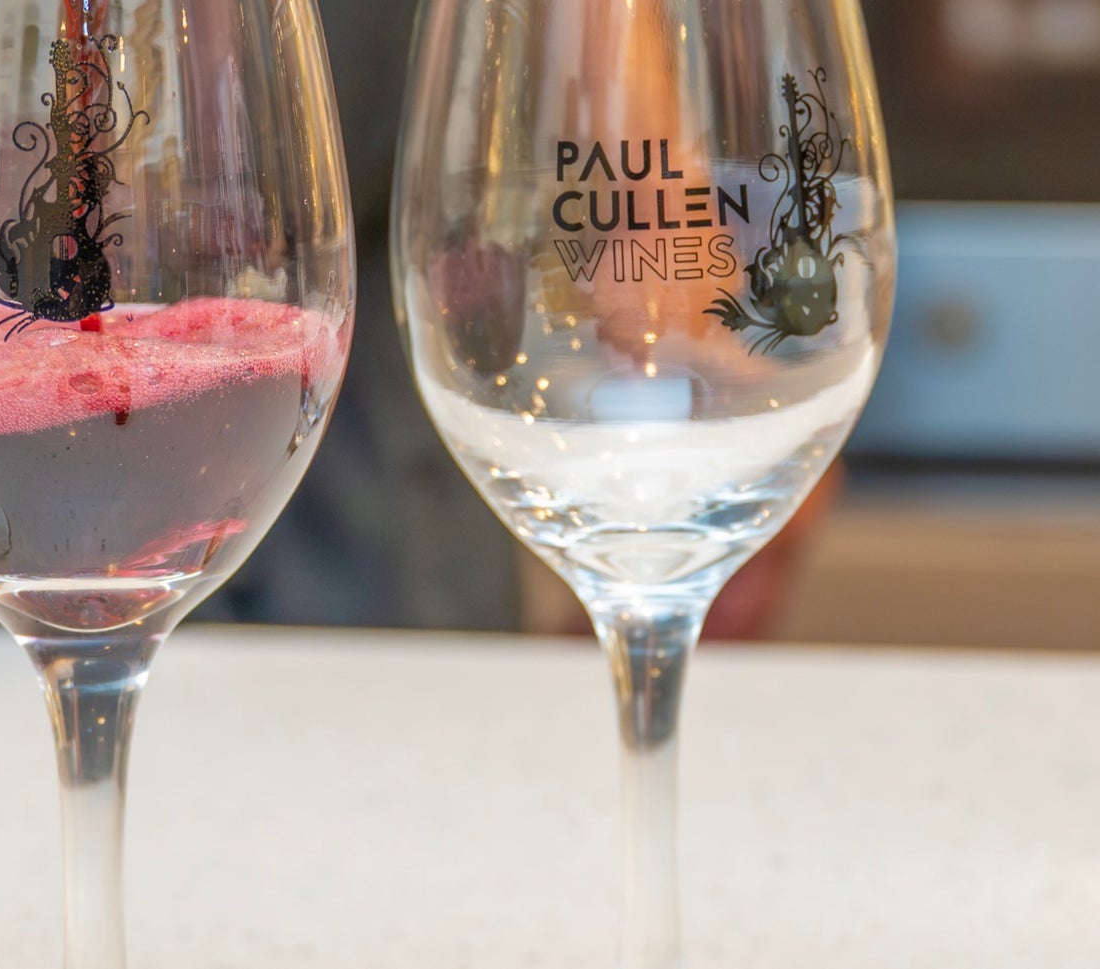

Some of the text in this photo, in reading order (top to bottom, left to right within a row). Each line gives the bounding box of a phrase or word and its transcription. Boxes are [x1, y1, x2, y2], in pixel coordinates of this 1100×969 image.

[556, 138, 684, 182] PAUL
[552, 184, 750, 232] CULLEN
[553, 234, 737, 283] WINES
